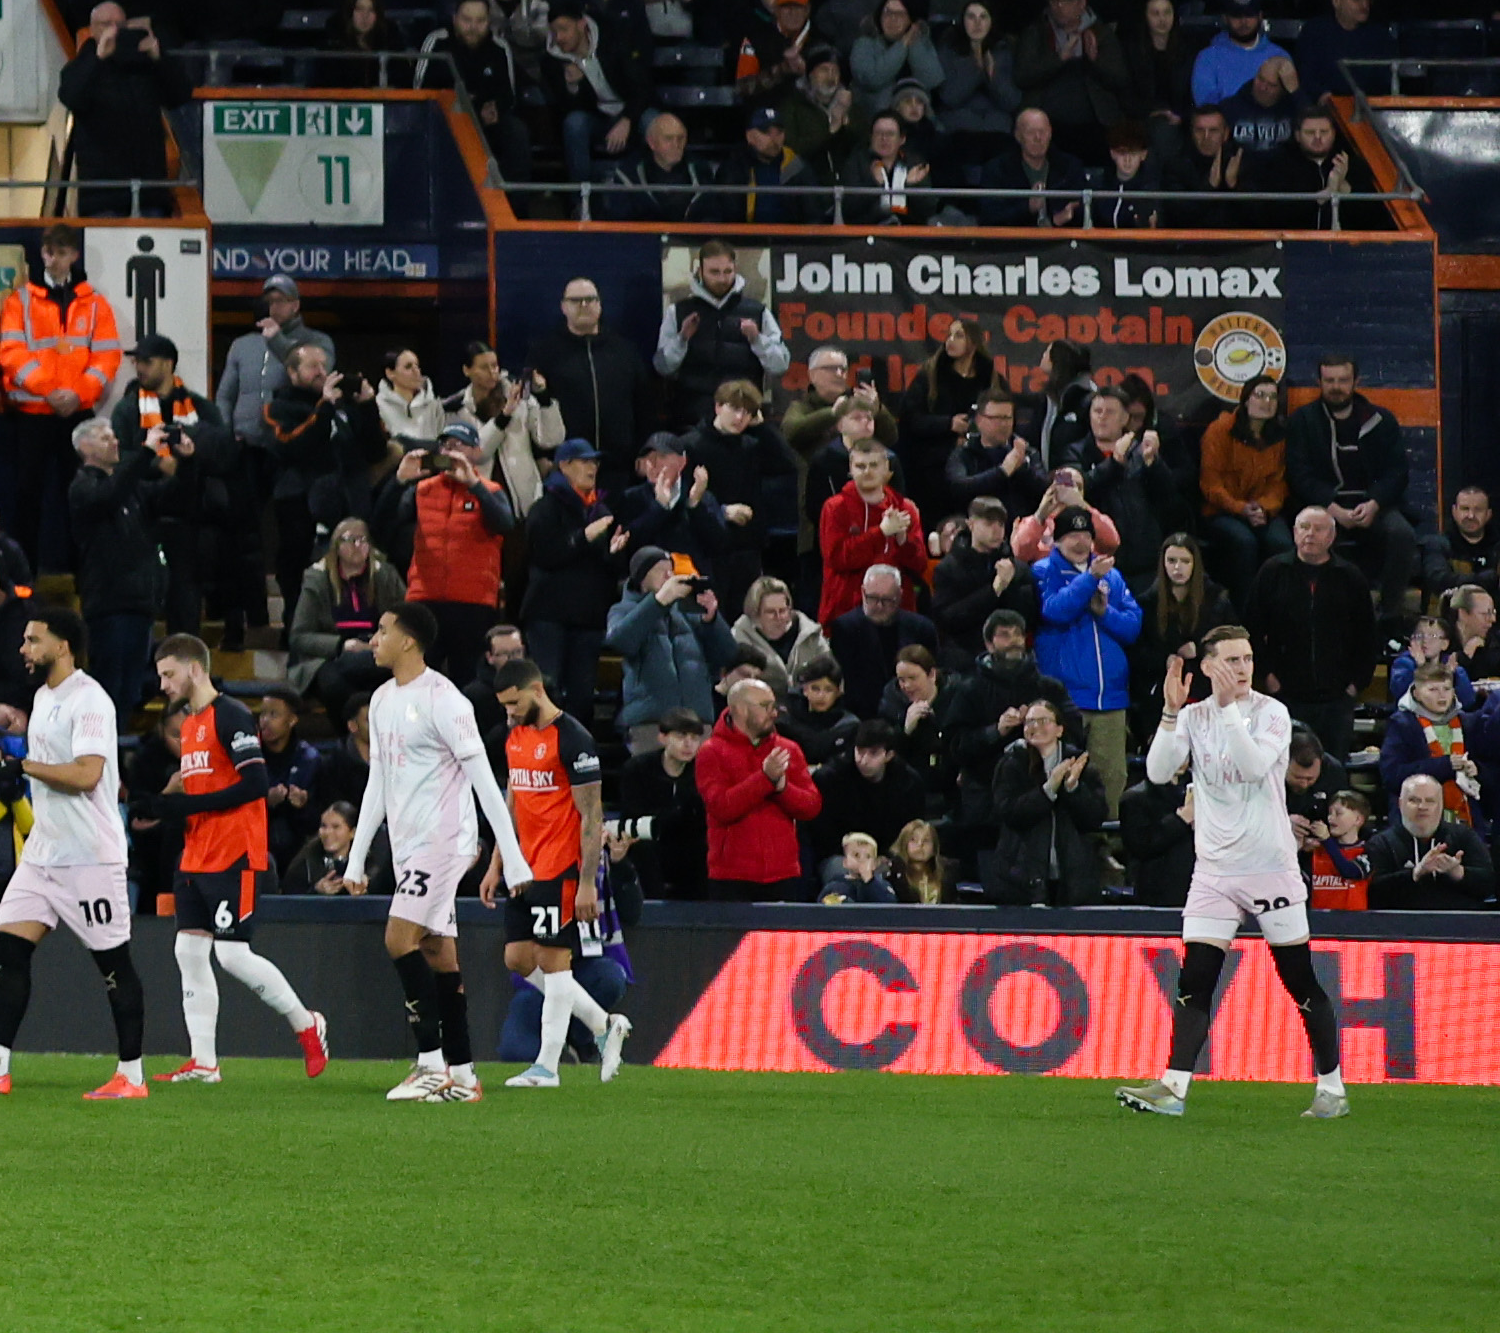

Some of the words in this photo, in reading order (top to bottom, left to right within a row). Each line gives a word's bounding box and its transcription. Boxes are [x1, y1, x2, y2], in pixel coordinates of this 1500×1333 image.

[224, 109, 280, 132] EXIT
[317, 155, 351, 206] 11
[264, 248, 330, 272] YOUR
[344, 249, 411, 272] HEAD
[776, 252, 893, 294] John
[906, 254, 1101, 297] Charles
[1113, 257, 1283, 299] Lomax
[1003, 304, 1195, 345] Captain
[394, 869, 431, 898] 23
[78, 897, 112, 928] 10
[214, 899, 233, 929] 6
[530, 905, 559, 936] 21
